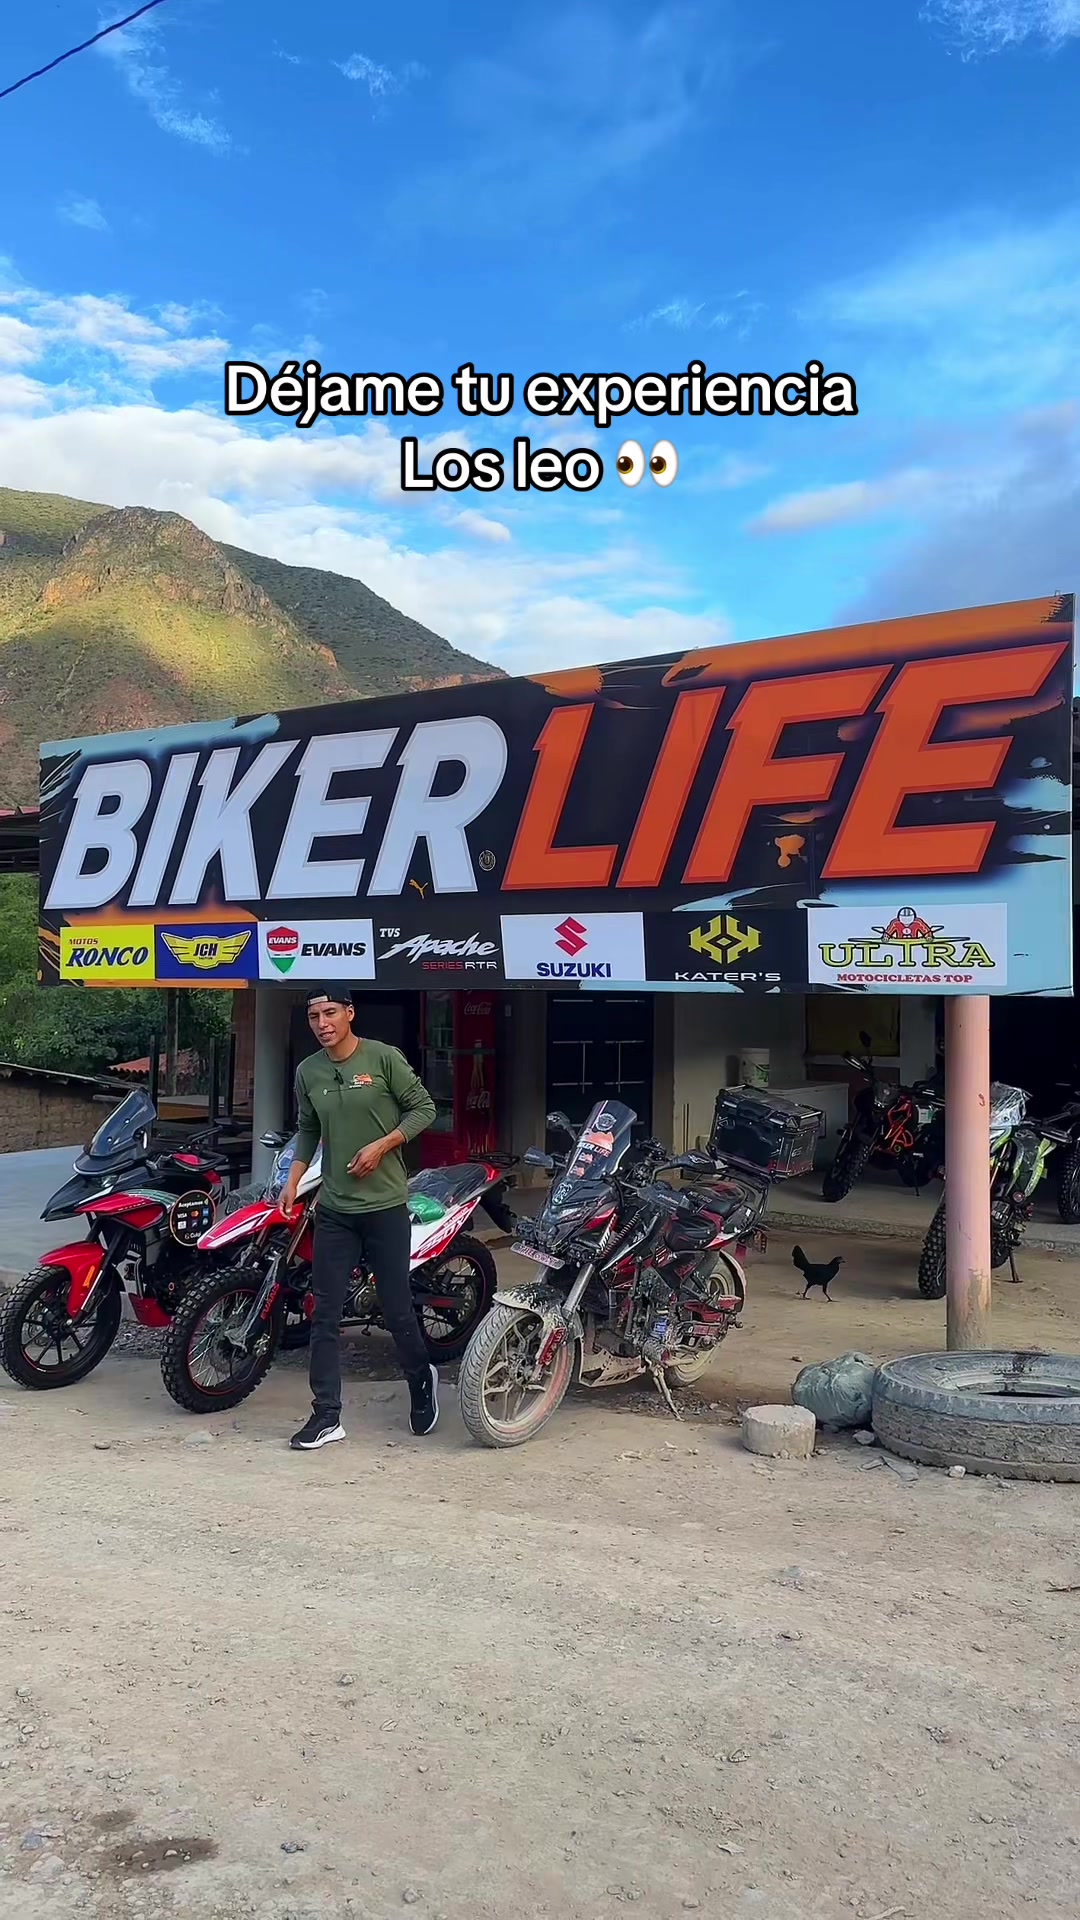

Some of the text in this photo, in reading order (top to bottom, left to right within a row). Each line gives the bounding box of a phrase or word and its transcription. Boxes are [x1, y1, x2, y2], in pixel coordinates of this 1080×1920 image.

[44, 641, 1069, 909] BIKER LIFE
[268, 936, 297, 944] EVANS
[379, 928, 401, 938] TVS
[193, 943, 218, 956] JCH
[301, 943, 366, 957] EVANS
[377, 932, 499, 964] Apache
[818, 938, 995, 968] ULTRA
[66, 947, 149, 967] RONCO
[537, 962, 611, 978] SUZUKI
[675, 971, 781, 982] KATER'S
[837, 973, 973, 983] MOTOCICLETAS TOP
